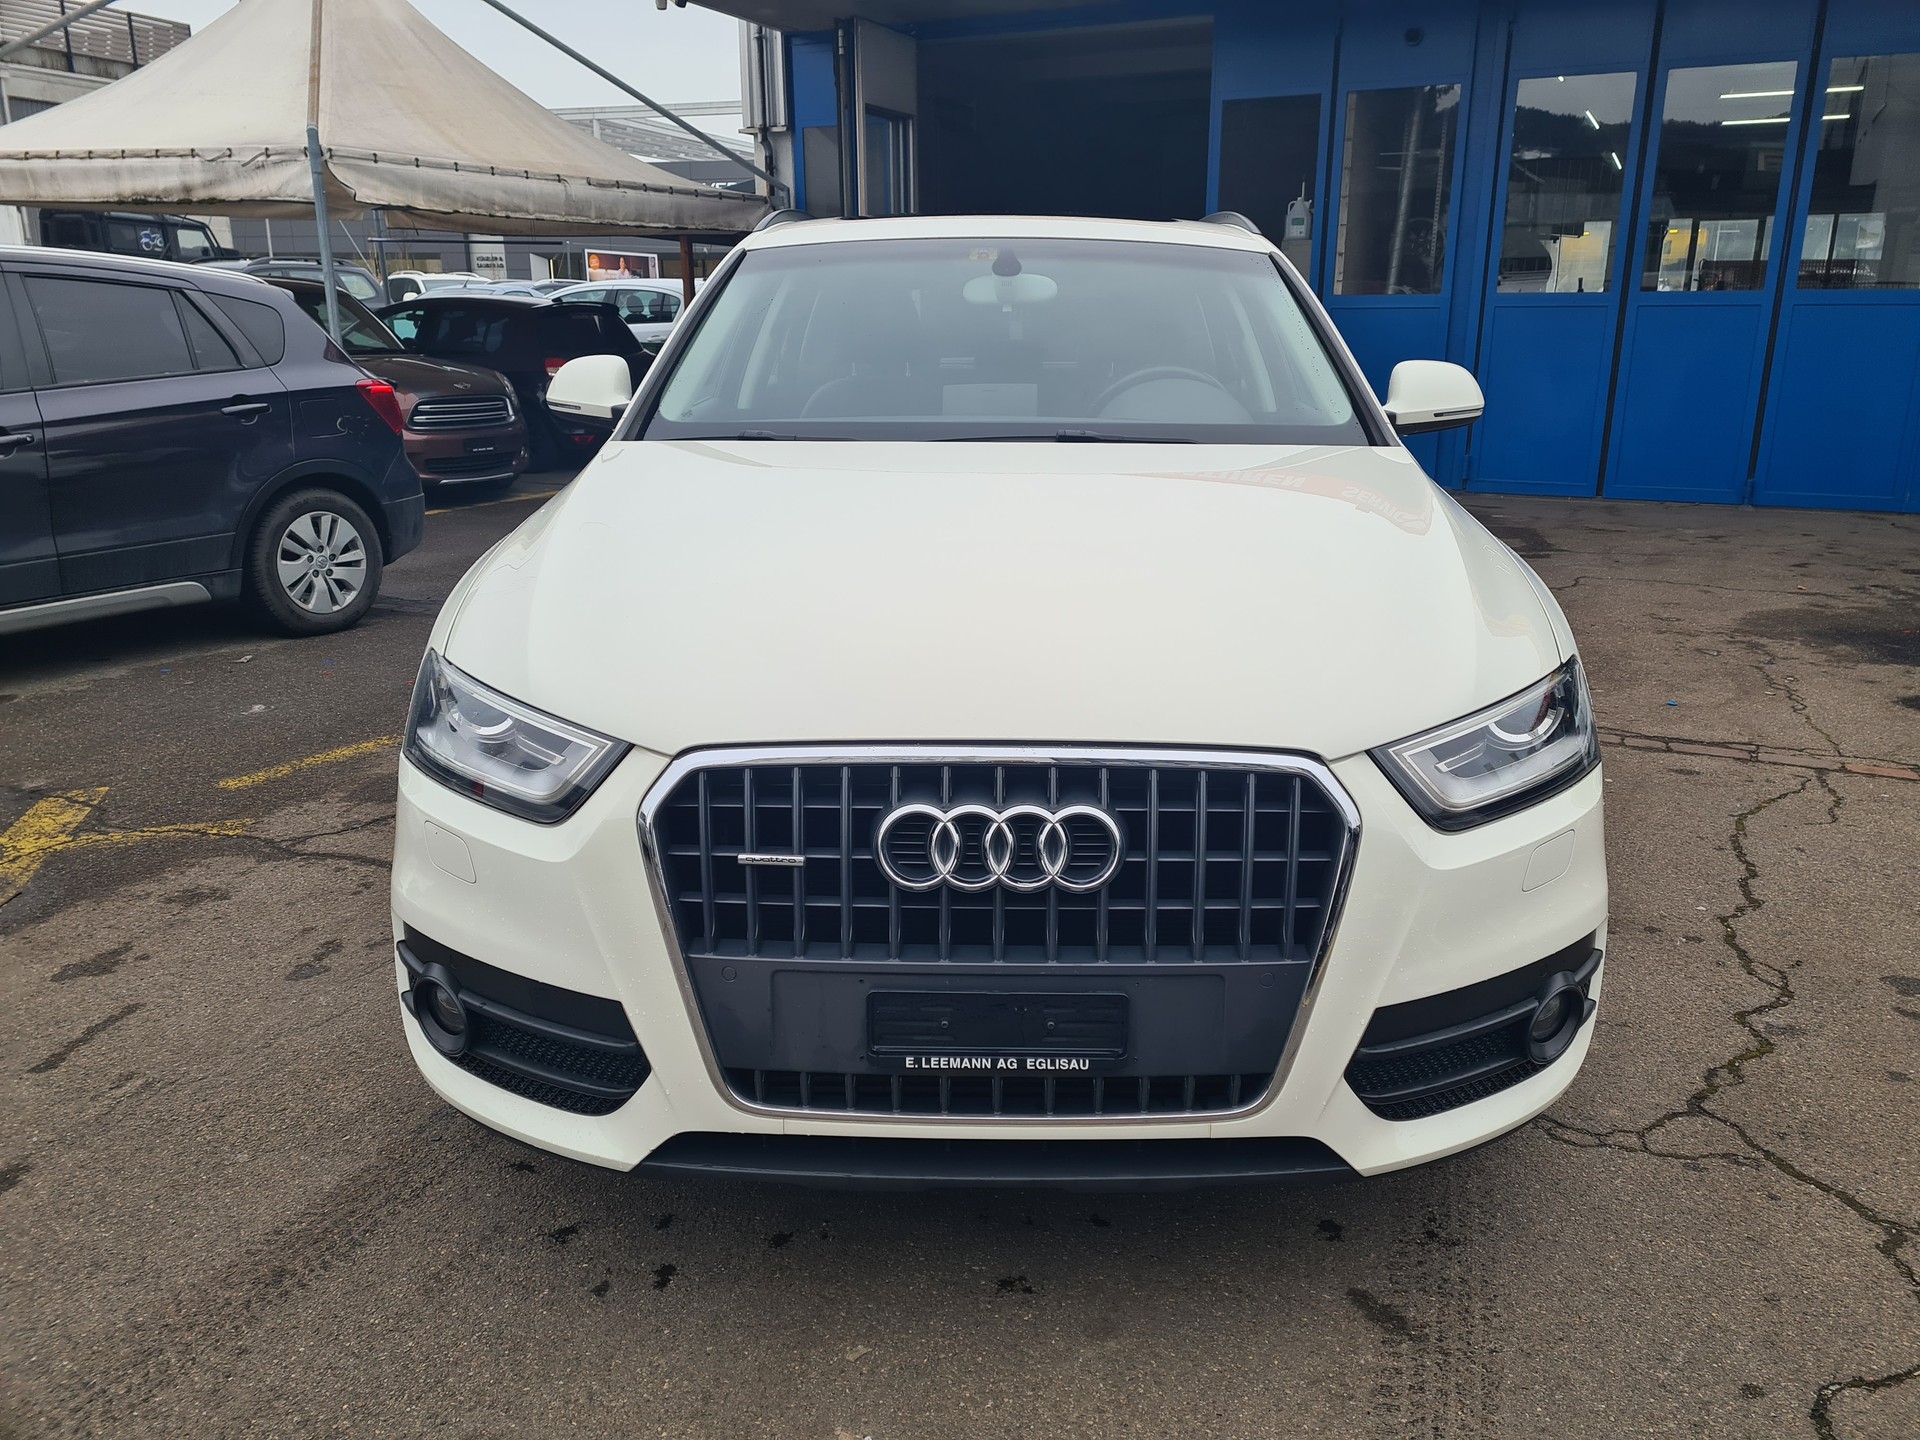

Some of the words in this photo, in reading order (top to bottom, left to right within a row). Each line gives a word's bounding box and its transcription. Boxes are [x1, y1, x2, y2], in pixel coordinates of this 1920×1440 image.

[905, 1057, 918, 1068] E.
[922, 1057, 991, 1069] LEEMANN
[997, 1058, 1018, 1069] AG
[1026, 1058, 1090, 1070] EGLISAU
